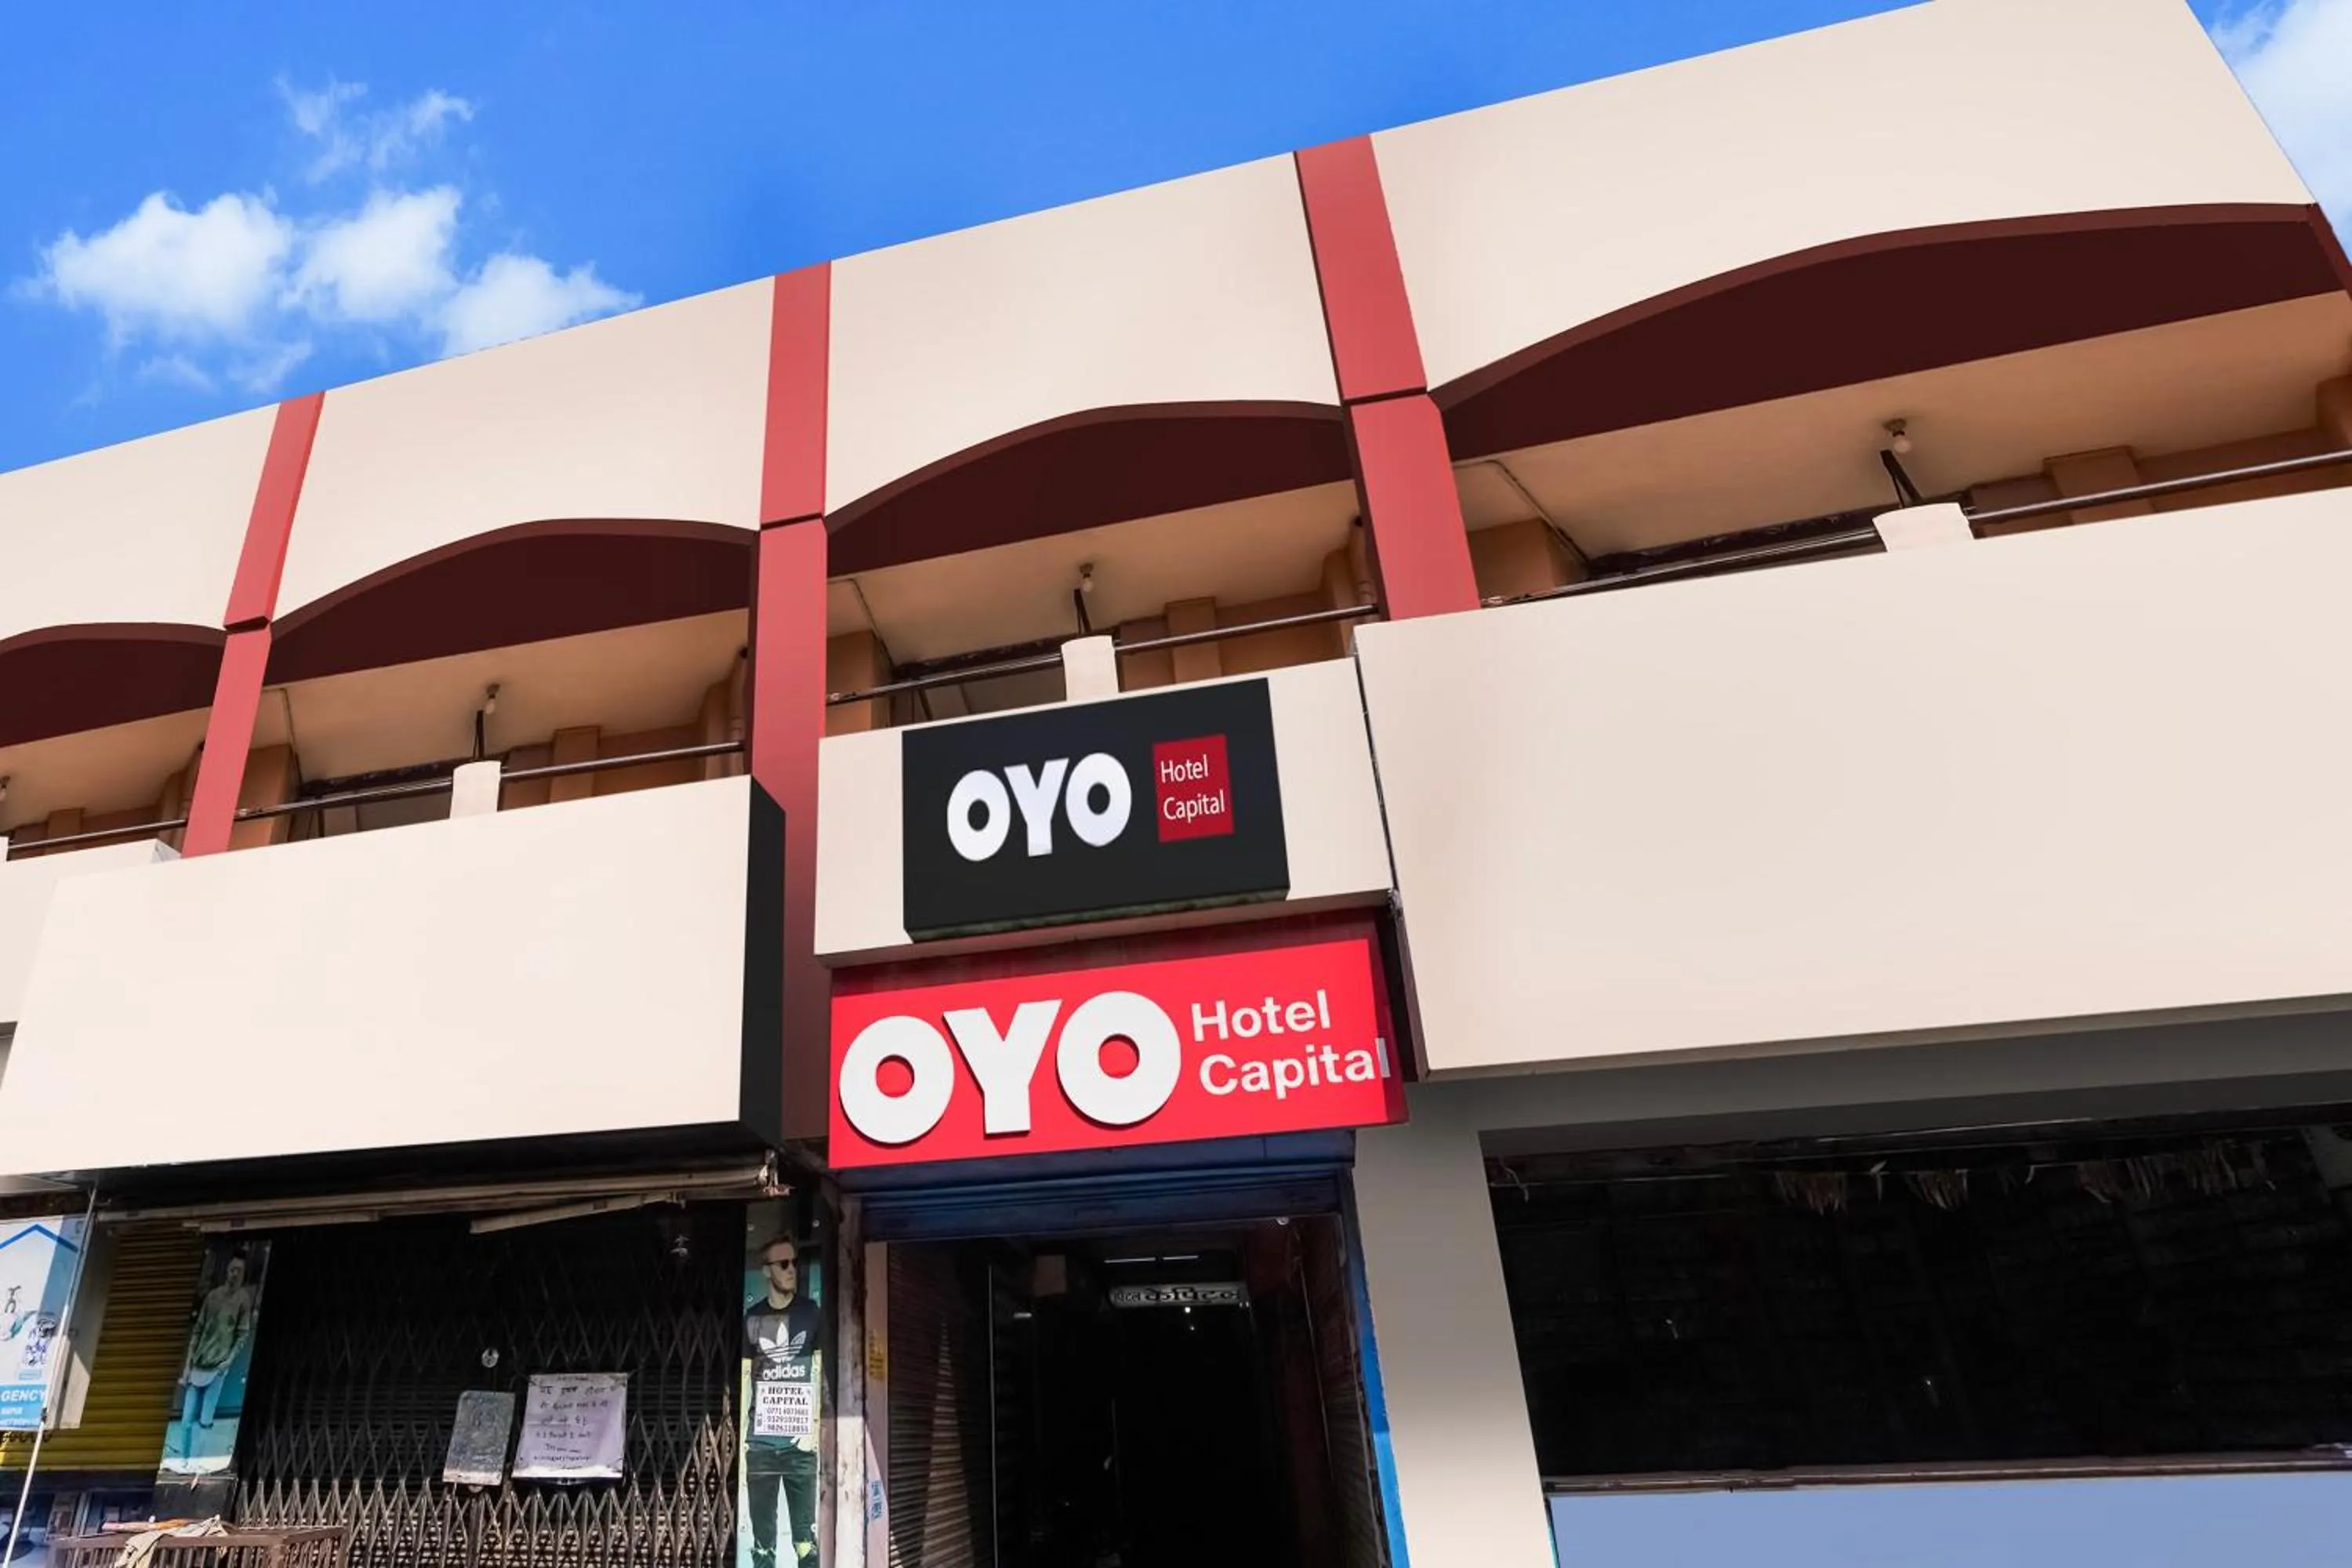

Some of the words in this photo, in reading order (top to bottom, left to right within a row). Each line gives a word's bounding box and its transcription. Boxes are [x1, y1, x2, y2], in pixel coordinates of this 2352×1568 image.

[1160, 753, 1208, 783] Hotel
[947, 752, 1131, 861] OYO
[1163, 789, 1225, 823] Capital
[1191, 989, 1330, 1042] Hotel
[839, 991, 1181, 1143] OYO
[1200, 1037, 1391, 1099] Capital
[763, 1364, 805, 1380] adidas
[763, 1396, 808, 1405] CAPITAL
[768, 1386, 804, 1395] HOTEL
